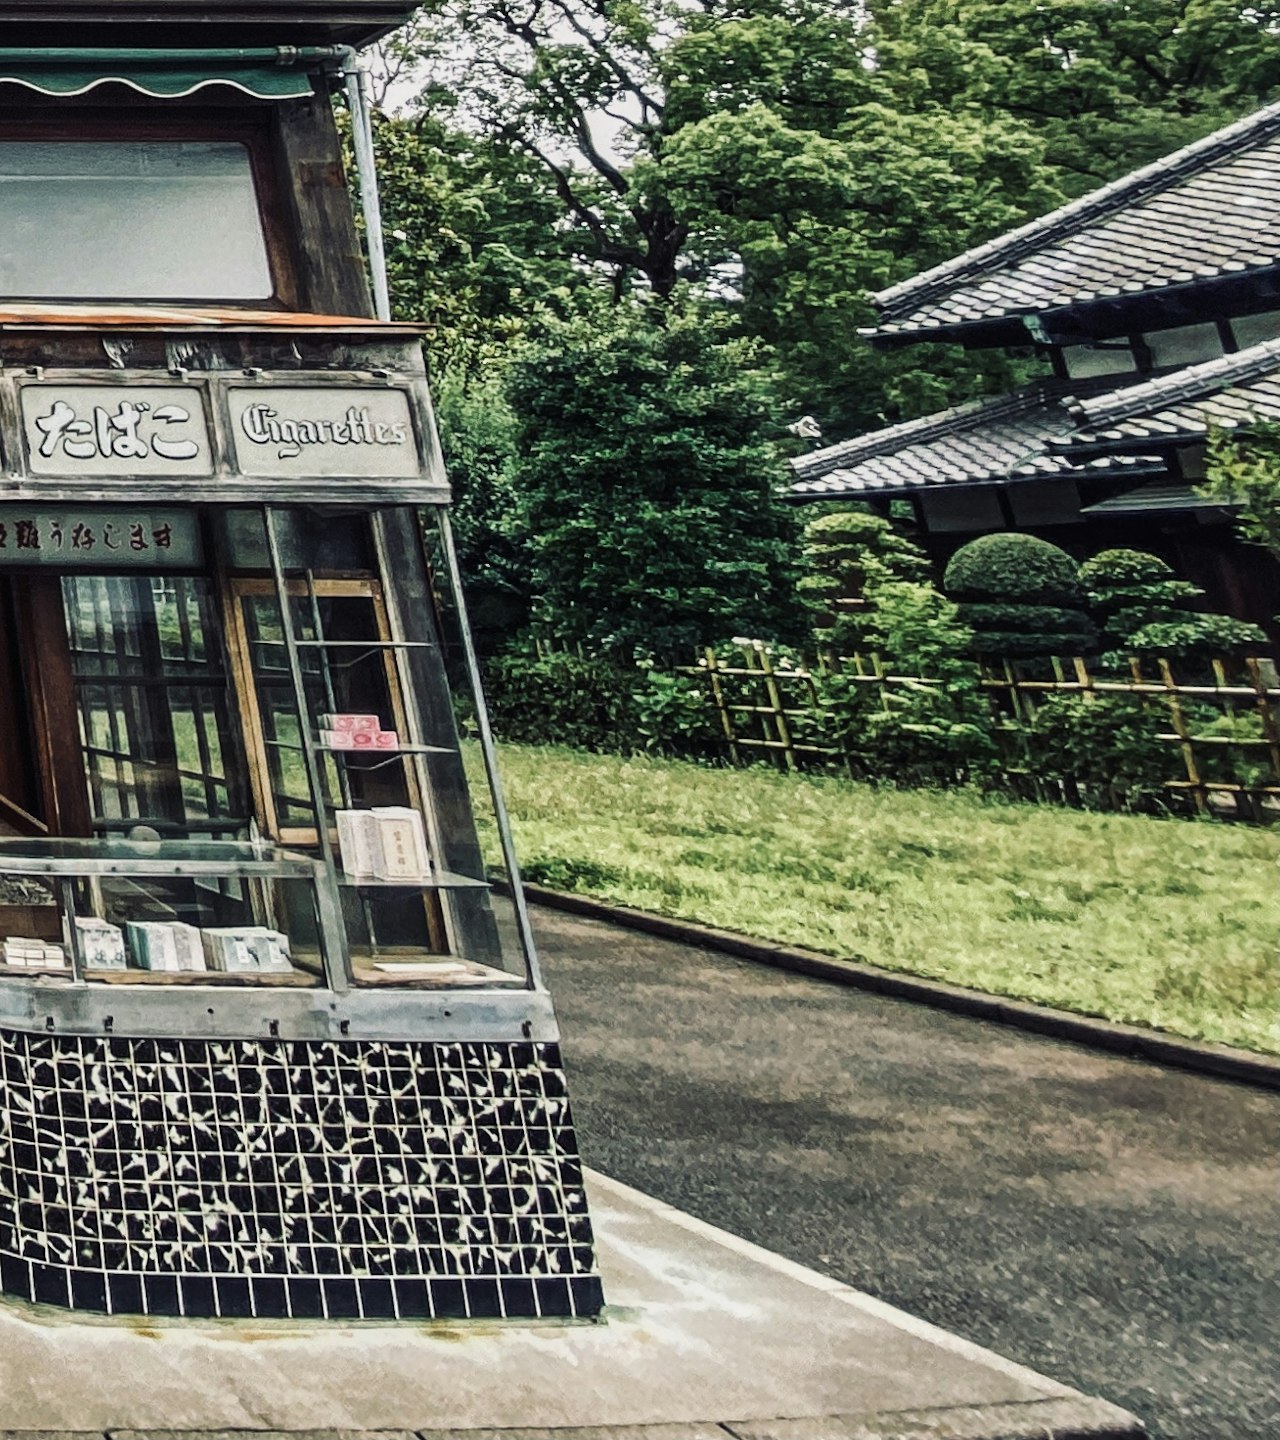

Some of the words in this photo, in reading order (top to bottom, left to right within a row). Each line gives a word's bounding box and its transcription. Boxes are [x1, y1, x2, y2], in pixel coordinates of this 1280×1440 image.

[37, 398, 200, 460] たばこ
[241, 402, 408, 459] Cigarettes
